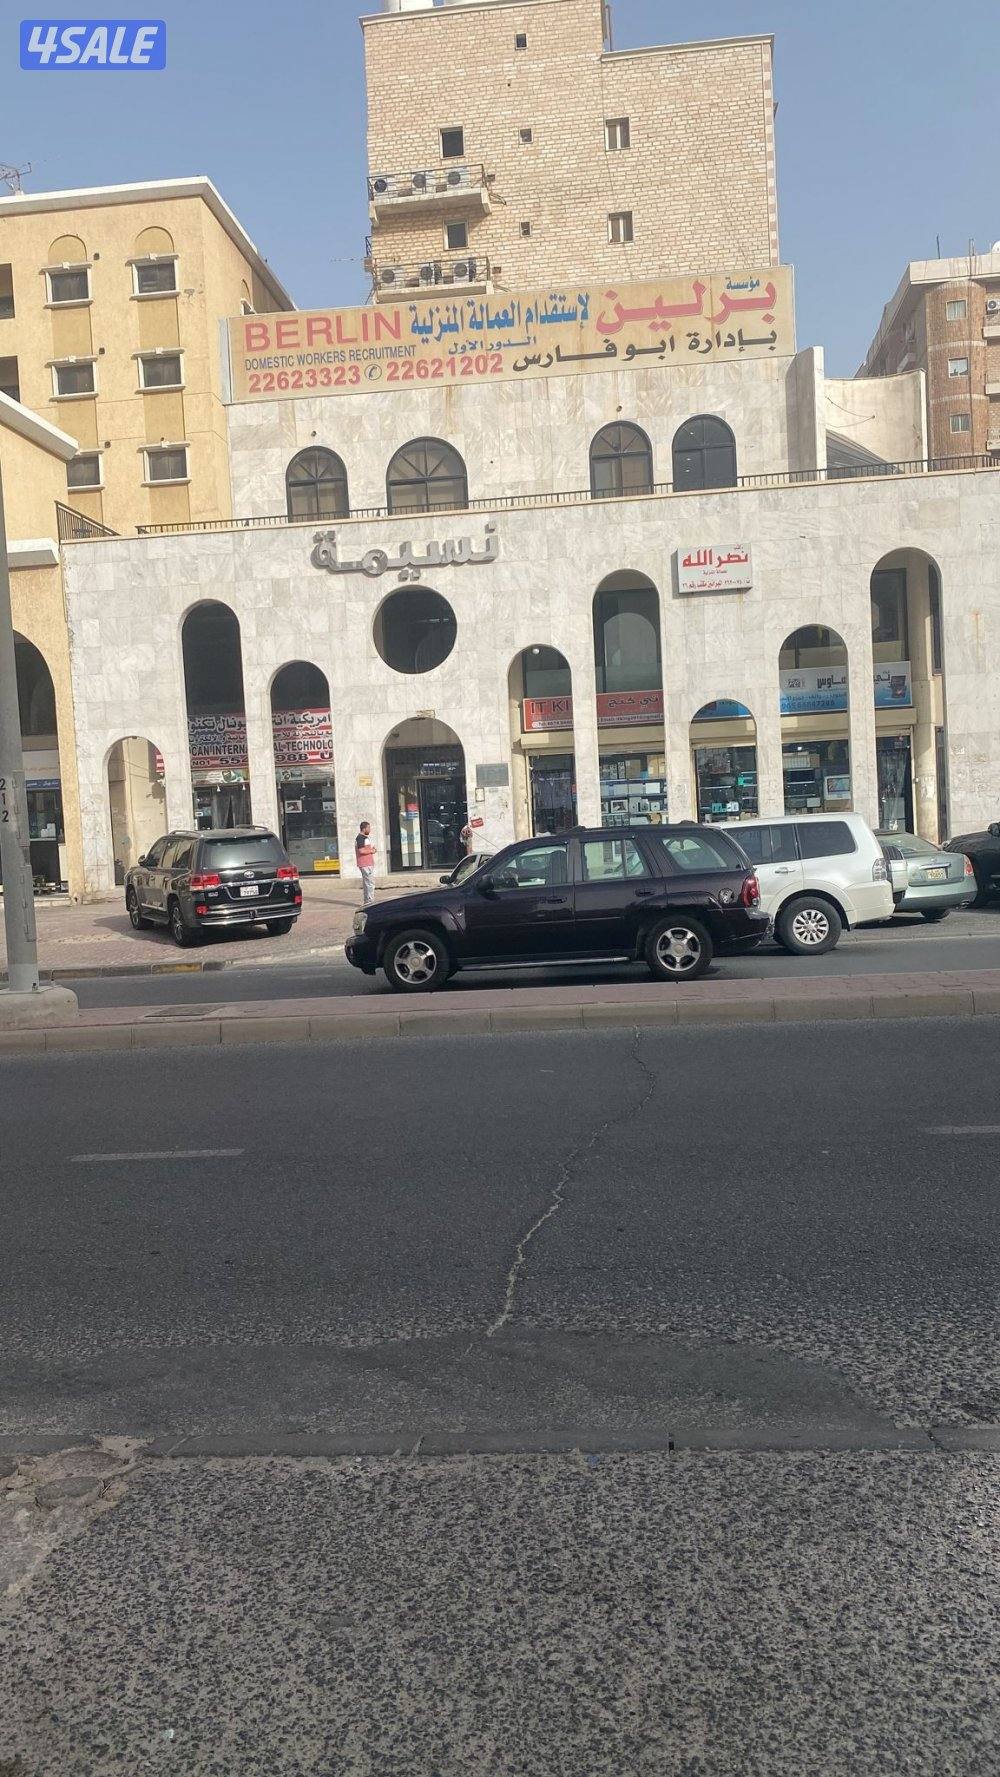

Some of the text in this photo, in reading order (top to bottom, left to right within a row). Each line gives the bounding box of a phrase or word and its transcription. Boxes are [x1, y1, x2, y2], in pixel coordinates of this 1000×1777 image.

[725, 276, 760, 292] مؤسسة
[467, 299, 521, 330] العمالة
[596, 279, 777, 335] برلين
[244, 310, 402, 352] BERLIN
[409, 304, 464, 344] المنزلية
[245, 345, 416, 371] DOMESTIC WORKERS RECRUITMENT
[512, 338, 617, 371] فارس
[249, 353, 504, 393] 22623323 22621202
[310, 520, 499, 582] نسيمة
[531, 701, 546, 713] IT
[286, 739, 333, 752] TECHNOLO
